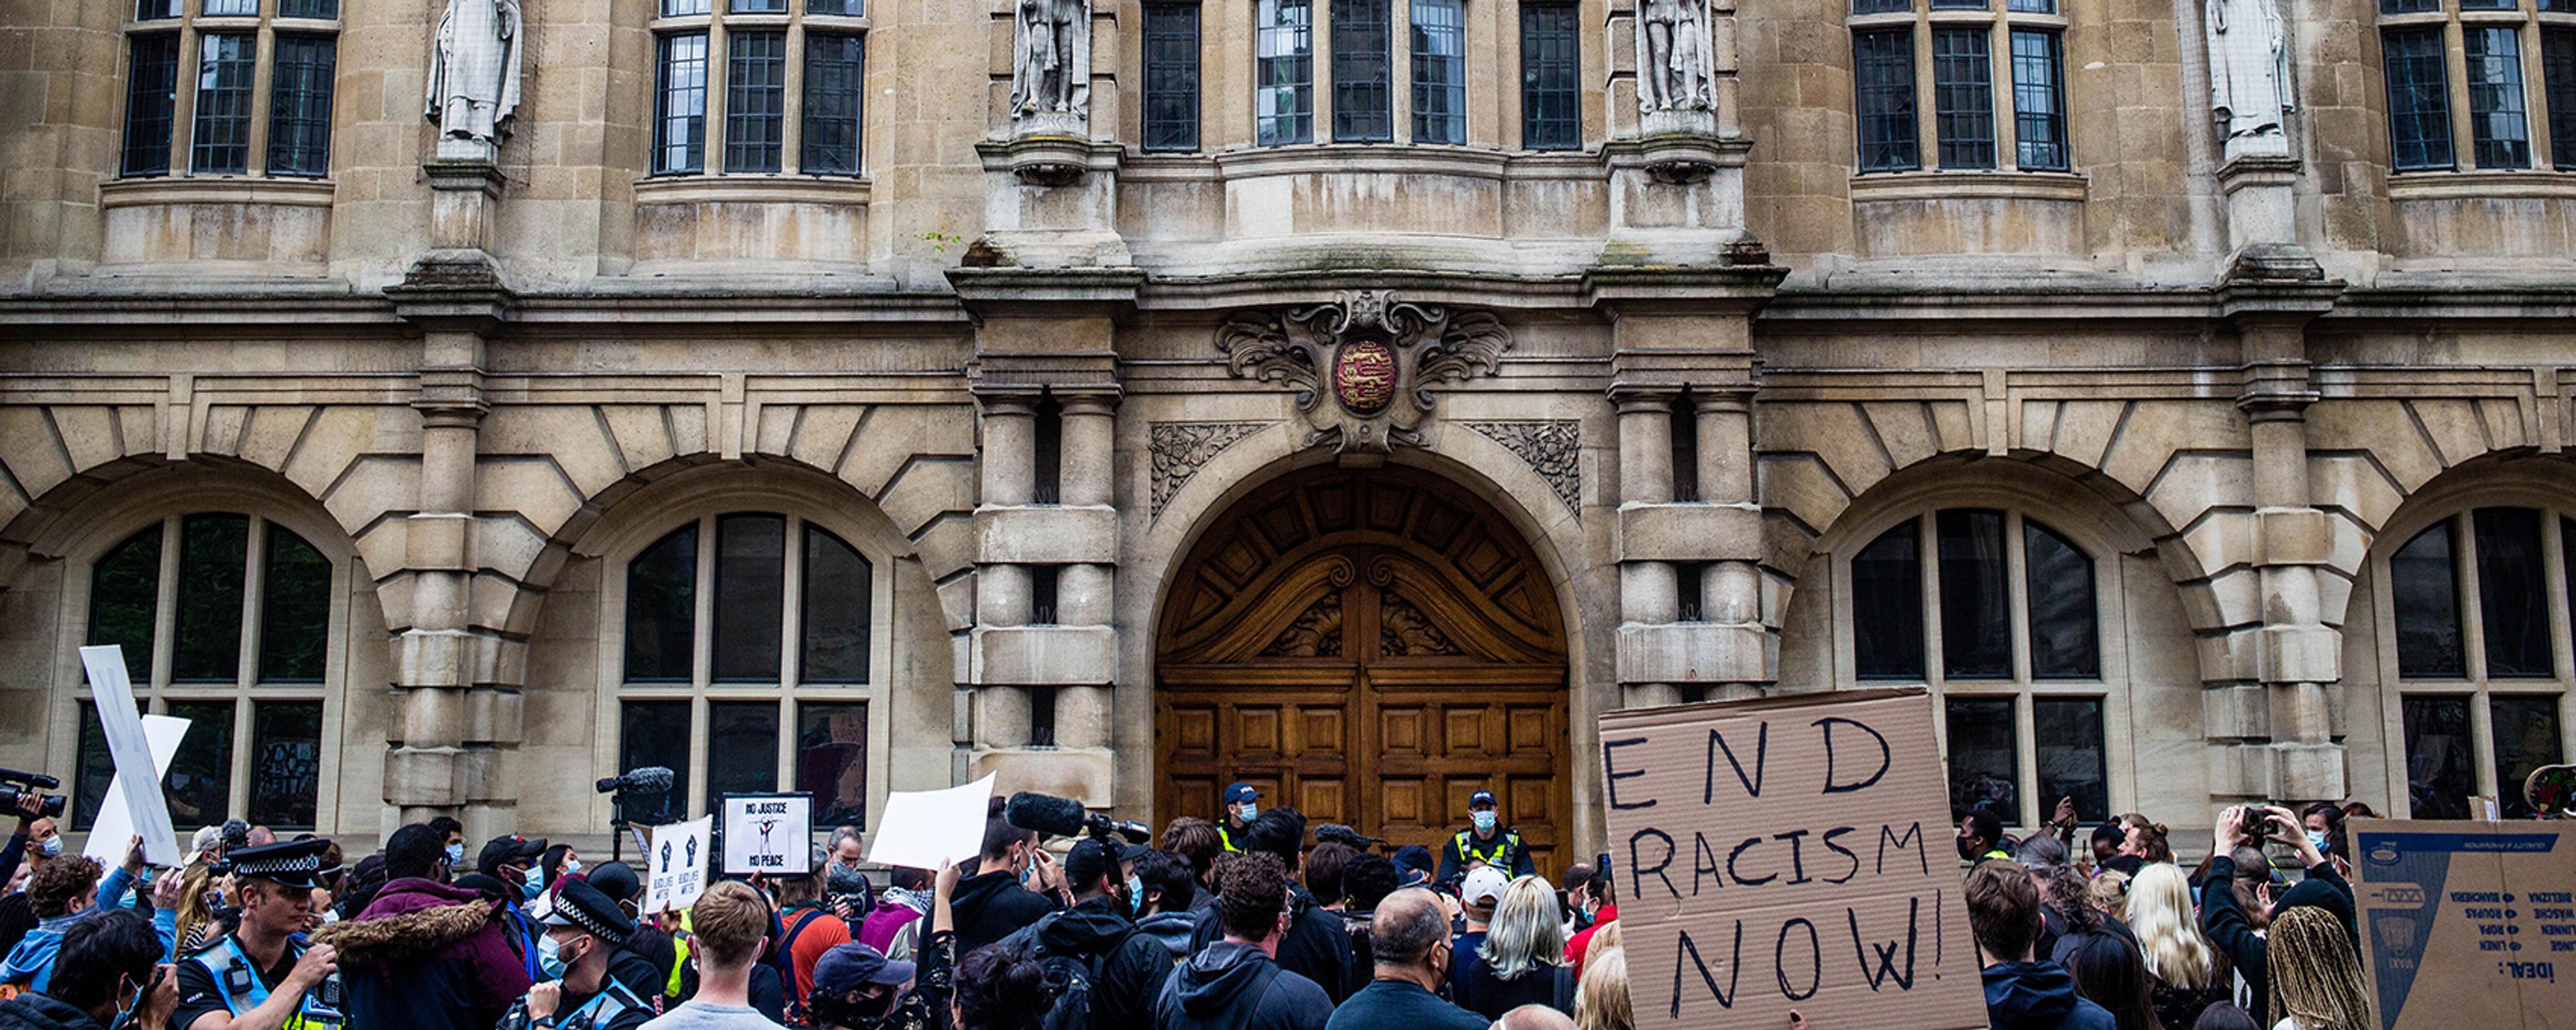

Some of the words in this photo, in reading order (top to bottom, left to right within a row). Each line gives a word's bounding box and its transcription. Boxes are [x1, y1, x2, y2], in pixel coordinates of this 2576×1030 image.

[1604, 717, 1891, 810] END
[746, 803, 756, 814] NO
[758, 802, 787, 814] JUSTICE
[749, 855, 759, 866] NO
[761, 854, 784, 866] PEACE
[1629, 821, 1929, 901] RACISM
[2450, 892, 2500, 903] BIANCHERIA
[2528, 893, 2572, 903] BIELIZNA
[2465, 909, 2502, 919] ROUPAS
[2534, 909, 2575, 921] WÄSCHE
[2479, 925, 2504, 935] ROPA
[2479, 941, 2507, 951] LINEN
[1670, 889, 1942, 1019] NOW!
[2388, 958, 2414, 970] MAXI
